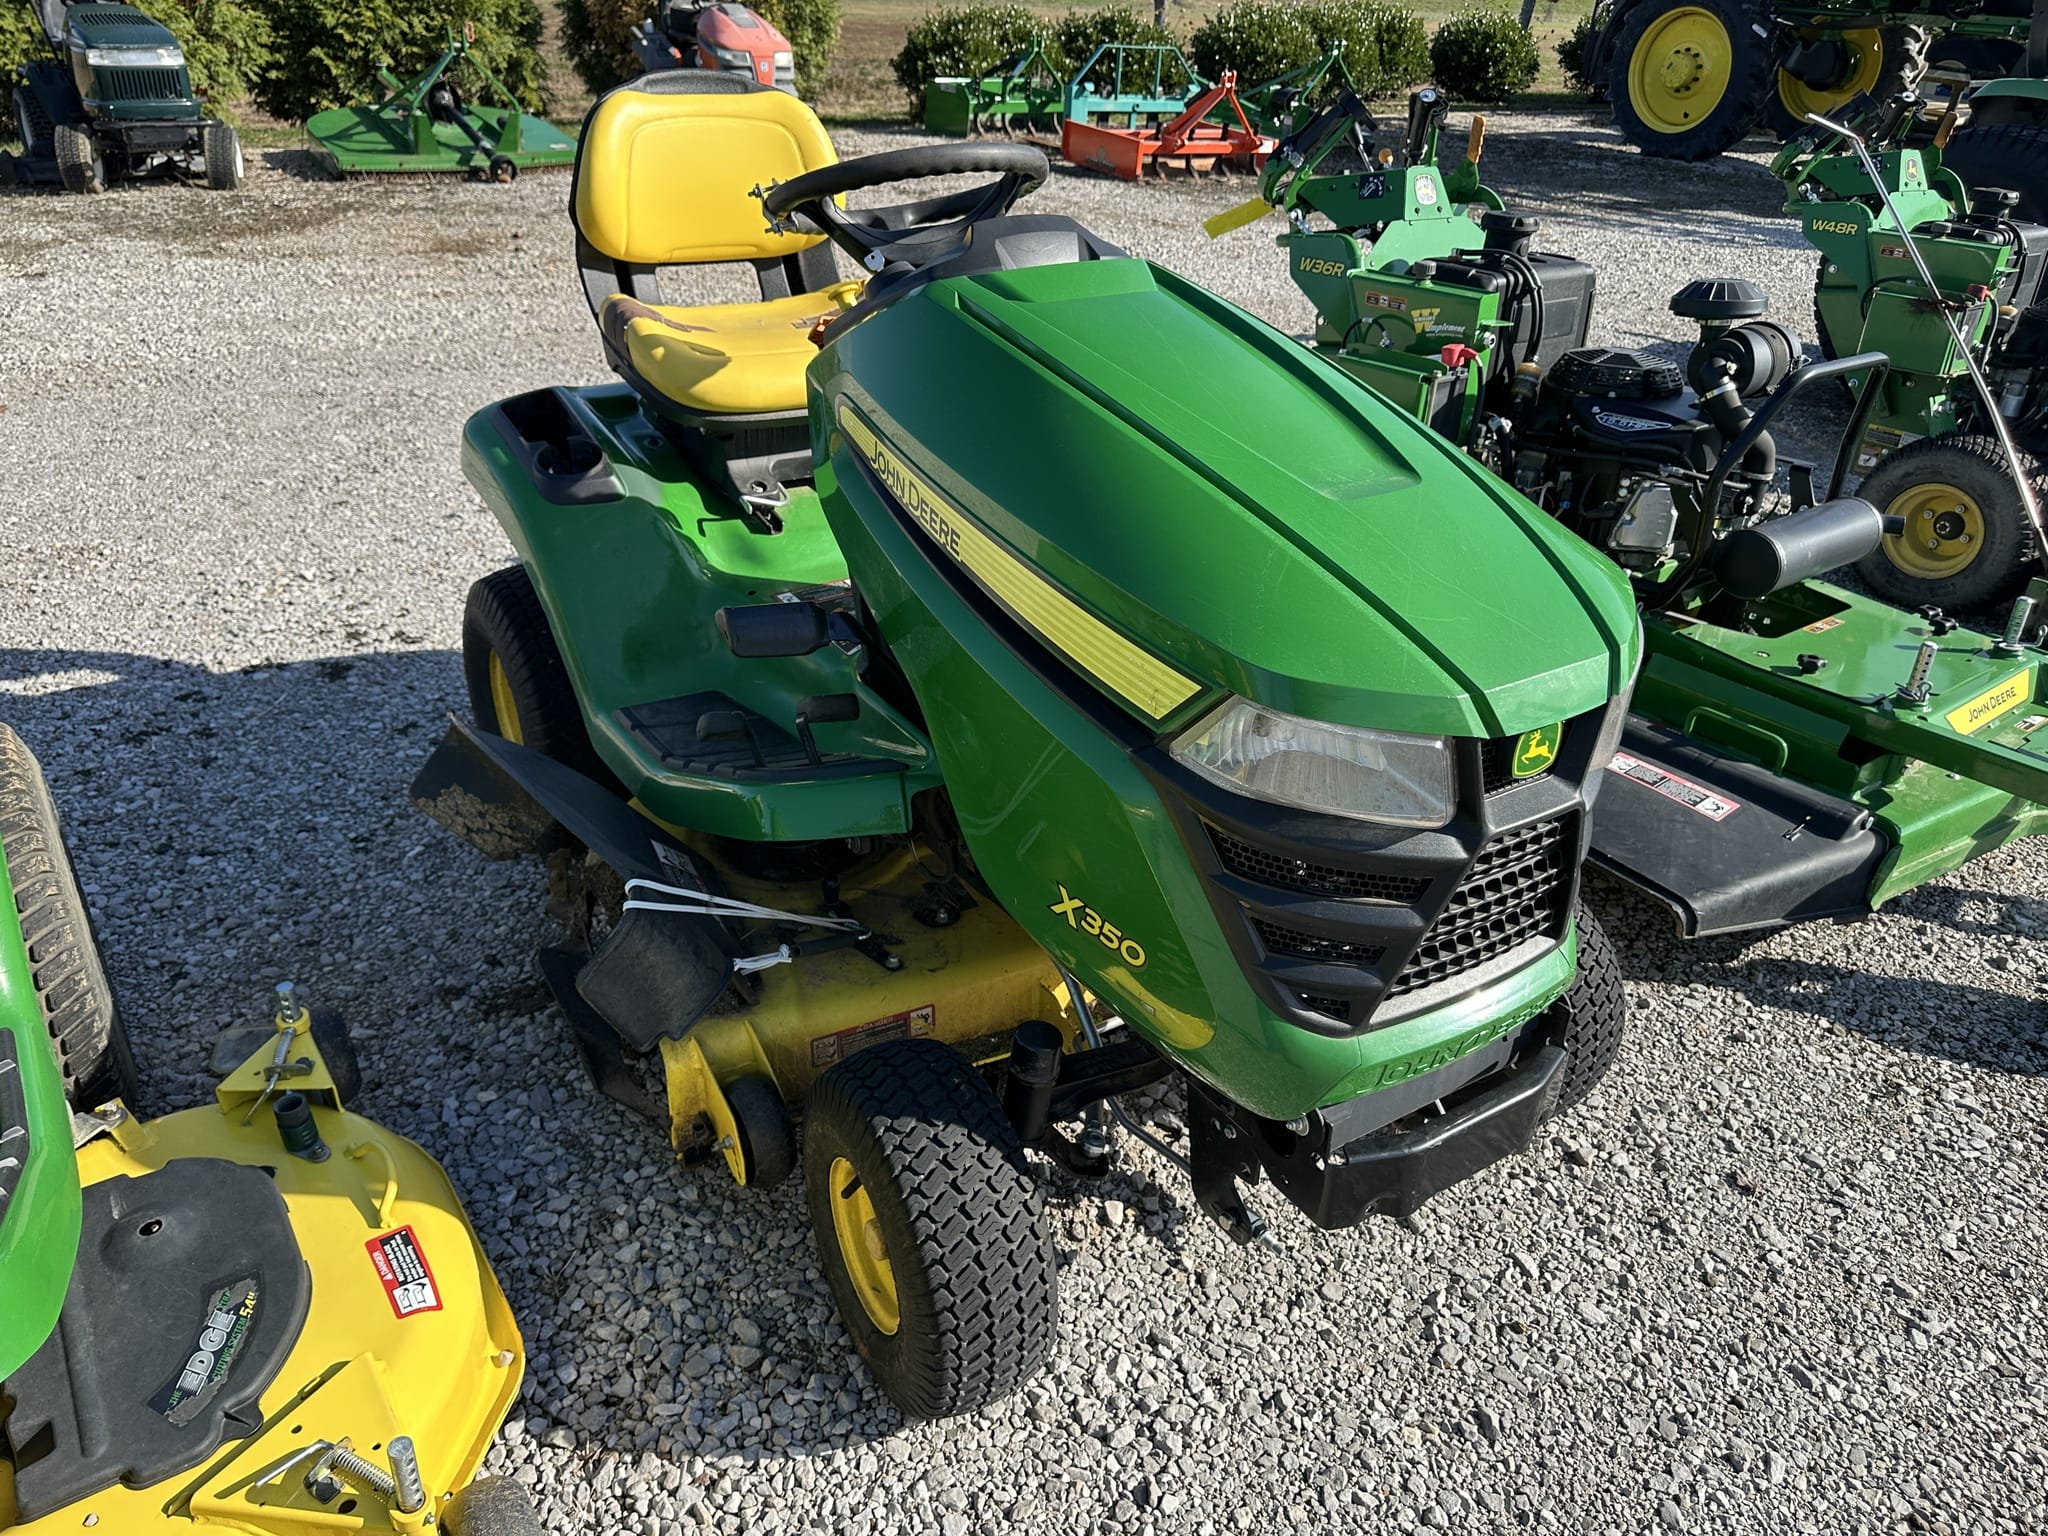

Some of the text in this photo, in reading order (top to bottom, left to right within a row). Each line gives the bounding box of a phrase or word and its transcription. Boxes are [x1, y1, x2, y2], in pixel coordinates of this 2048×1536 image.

[1812, 219, 1858, 236] W48R
[1300, 257, 1345, 278] W36R
[870, 440, 961, 557] JOHN DEERE
[1969, 702, 1990, 723] JOHN
[1989, 687, 2017, 710] DEERE
[1048, 881, 1147, 967] X350
[1356, 1039, 1464, 1094] JOHN
[372, 1250, 389, 1276] DANGER
[176, 1309, 237, 1396] EDGE
[213, 1348, 234, 1380] CUTTING
[228, 1317, 248, 1349] SYSTEM
[168, 1389, 183, 1406] THE
